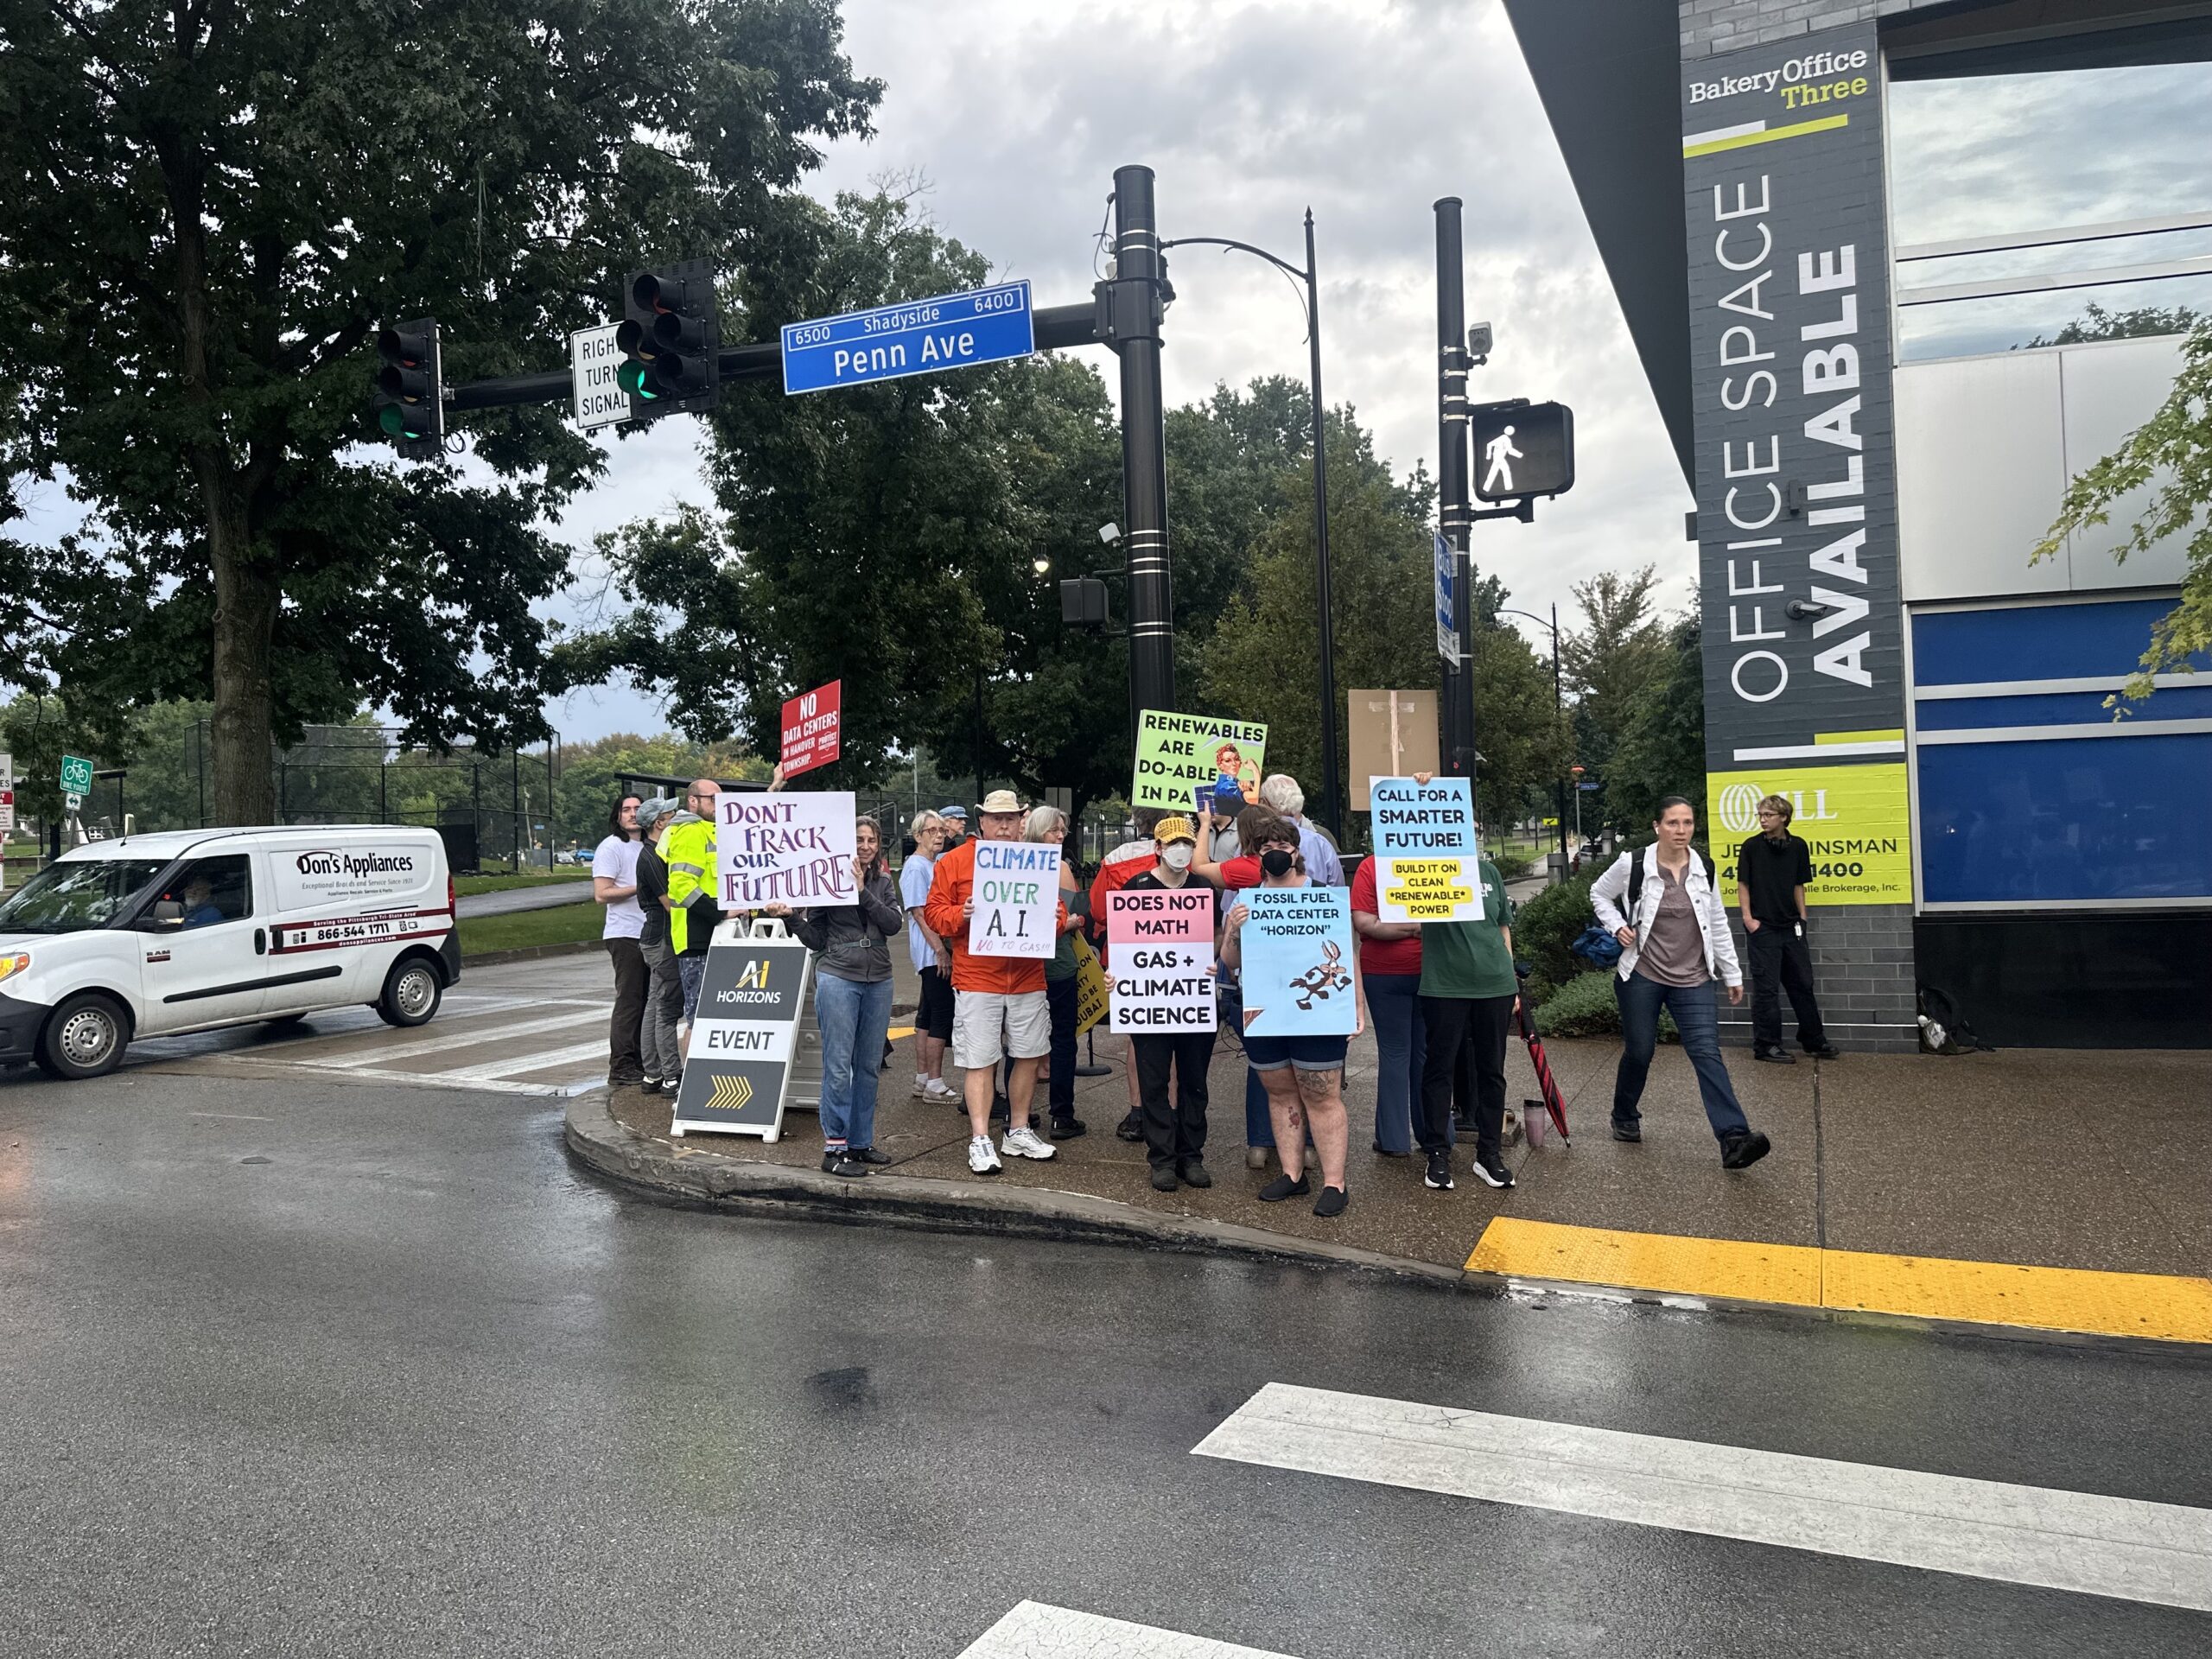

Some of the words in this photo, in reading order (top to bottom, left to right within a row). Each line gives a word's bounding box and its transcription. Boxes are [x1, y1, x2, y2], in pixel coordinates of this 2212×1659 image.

[1689, 69, 1781, 104] Bakery
[1782, 49, 1867, 83] Office
[1781, 77, 1868, 110] Three
[1714, 175, 1777, 410] SPACE
[795, 327, 831, 345] 6500
[864, 306, 940, 334] Shadyside
[974, 292, 1014, 313] 6400
[582, 336, 620, 359] RIGH
[834, 343, 906, 377] Penn
[921, 331, 975, 363] Ave
[582, 390, 629, 416] SIGNAL
[1798, 245, 1872, 688] AVAILABLE
[1438, 541, 1451, 580] Bus
[1724, 435, 1789, 702] OFFICE
[1437, 582, 1452, 624] Stop
[799, 693, 817, 721] NO
[783, 725, 802, 745] DATA
[803, 710, 837, 737] CENTERS
[1145, 715, 1264, 742] RENEWABLES
[783, 747, 790, 760] IN
[790, 737, 816, 756] HANOVER
[1158, 740, 1195, 756] ARE
[784, 753, 812, 773] TOWNSHIP.
[1139, 759, 1217, 782] DO-ABLE
[1141, 785, 1162, 801] IN
[1167, 788, 1192, 804] PA
[1377, 789, 1414, 802] CALL
[1418, 789, 1448, 802] FOR
[1451, 789, 1463, 802] A
[723, 801, 798, 825] DON'T
[1379, 809, 1465, 824] SMARTER
[744, 825, 832, 854] FRACK
[1385, 832, 1463, 848] FUTURE!
[1809, 838, 1897, 855] INSMAN
[296, 852, 340, 874] Don's
[343, 853, 413, 878] Appliances
[976, 846, 1059, 871] CLIMATE
[1395, 864, 1426, 874] BUILD
[1428, 864, 1439, 873] IT
[1441, 863, 1457, 873] ON
[302, 880, 334, 891] Exceptional
[368, 878, 387, 887] Service
[982, 880, 1039, 905] OVER
[1408, 878, 1444, 887] CLEAN
[1822, 884, 1879, 893] Brokerage,
[1882, 883, 1901, 892] Inc.
[1113, 895, 1164, 911] DOES
[1169, 895, 1210, 910] NOT
[1254, 893, 1299, 904] FOSSIL
[1301, 893, 1335, 903] FUEL
[1251, 909, 1285, 920] DATA
[1287, 908, 1339, 919] CENTER
[1410, 905, 1450, 915] POWER
[317, 926, 365, 941] 866-544
[368, 923, 391, 935] 1711
[1135, 919, 1189, 935] MATH
[338, 935, 397, 947] donsappliances.com
[976, 939, 994, 952] NO
[1001, 940, 1015, 950] TO
[1133, 950, 1178, 969] GAS
[1183, 955, 1194, 967] +
[735, 960, 770, 988] AI
[716, 990, 782, 1004] HORIZONS
[1088, 984, 1099, 997] BE
[1116, 978, 1211, 997] CLIMATE
[1119, 1007, 1211, 1025] SCIENCE
[708, 1030, 775, 1051] EVENT
